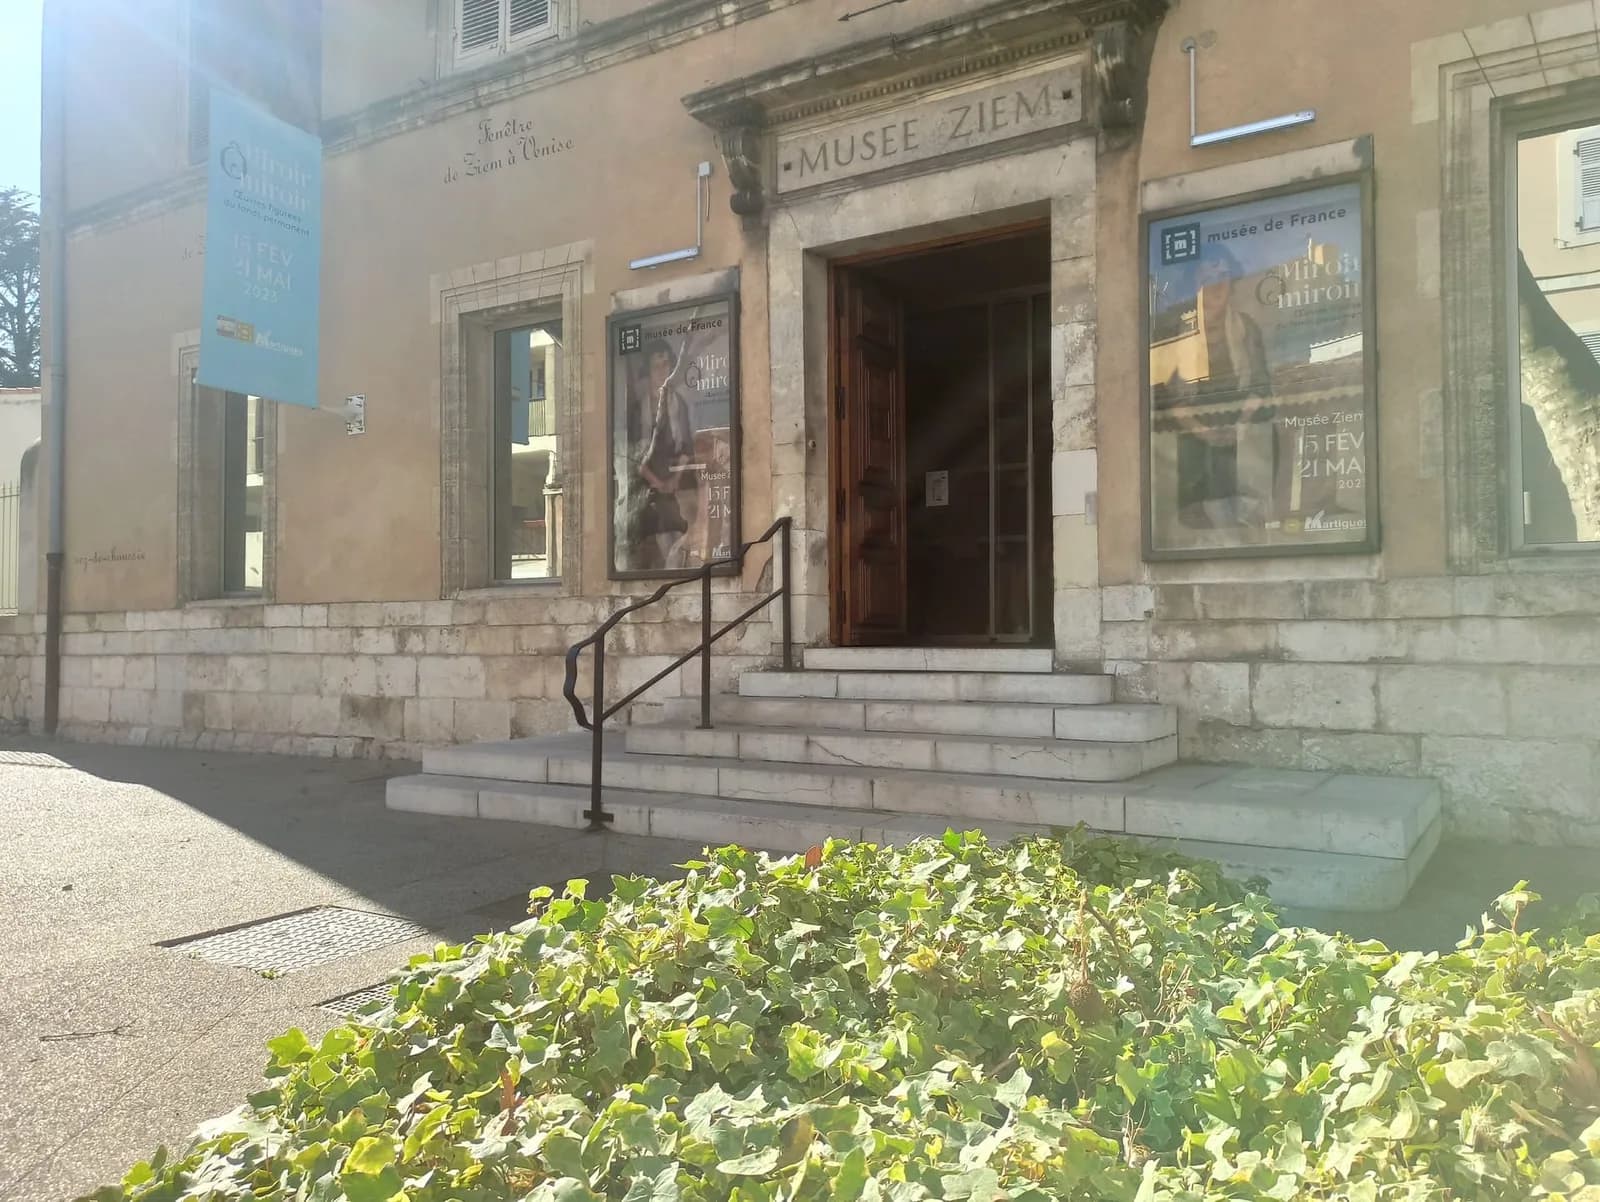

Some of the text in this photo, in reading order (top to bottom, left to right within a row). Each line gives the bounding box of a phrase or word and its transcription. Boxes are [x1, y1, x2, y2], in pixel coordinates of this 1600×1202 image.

[478, 117, 533, 145] Fenêtre
[799, 85, 1053, 178] MUSEE ZIEM
[443, 135, 575, 184] de Ziem à Venise
[263, 214, 312, 238] permanent
[1207, 206, 1347, 243] musée de France
[256, 264, 293, 292] MAI
[644, 318, 723, 341] musée de France
[1284, 413, 1329, 428] Musée
[1298, 428, 1365, 455] 15 FÉV
[1297, 459, 1318, 478] 21
